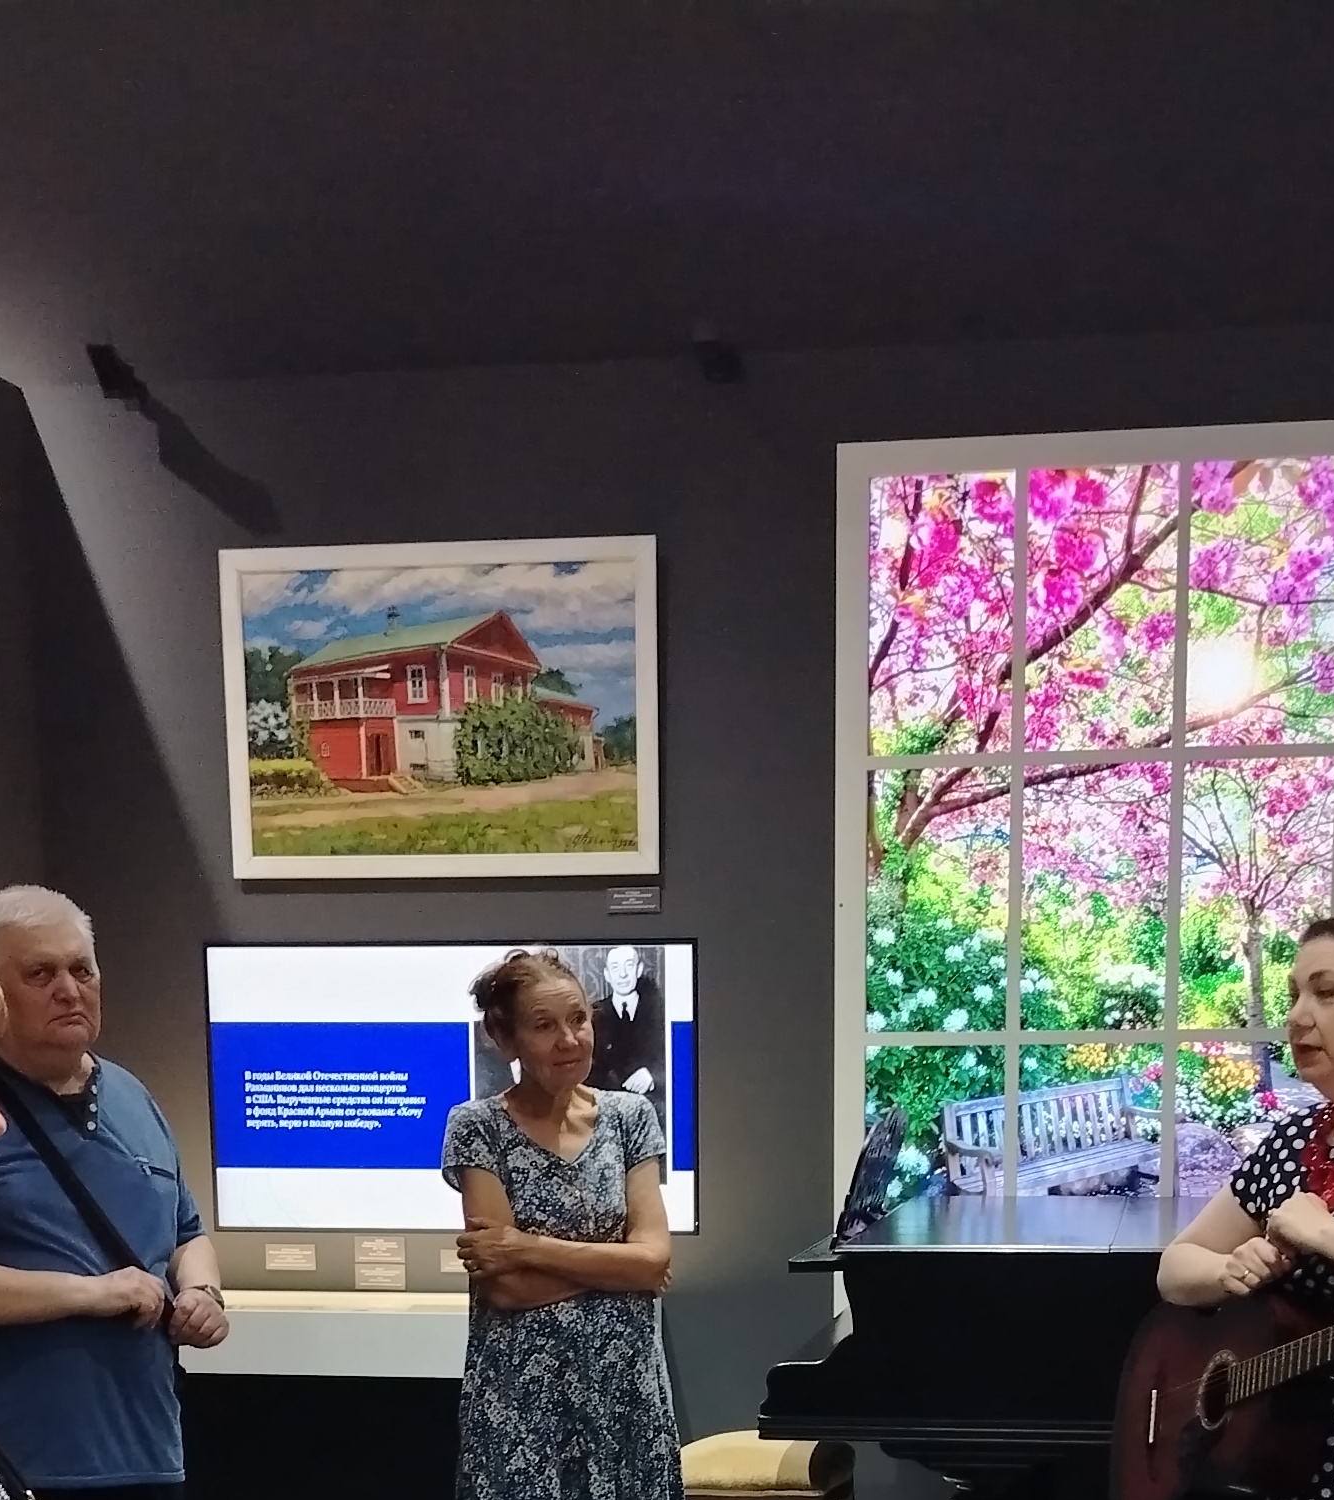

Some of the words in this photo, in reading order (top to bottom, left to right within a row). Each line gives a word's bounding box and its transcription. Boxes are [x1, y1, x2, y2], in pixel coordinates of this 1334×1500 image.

[275, 1071, 312, 1080] Великой
[313, 1071, 378, 1081] Отечественной
[380, 1071, 408, 1081] войны
[245, 1082, 297, 1092] Рахманинов
[315, 1084, 360, 1092] несколько
[361, 1084, 407, 1095] концертов
[277, 1095, 331, 1106] Вырученные
[332, 1096, 370, 1106] средства
[384, 1096, 426, 1106] направил
[277, 1106, 314, 1118] Красной
[315, 1107, 344, 1118] Армии
